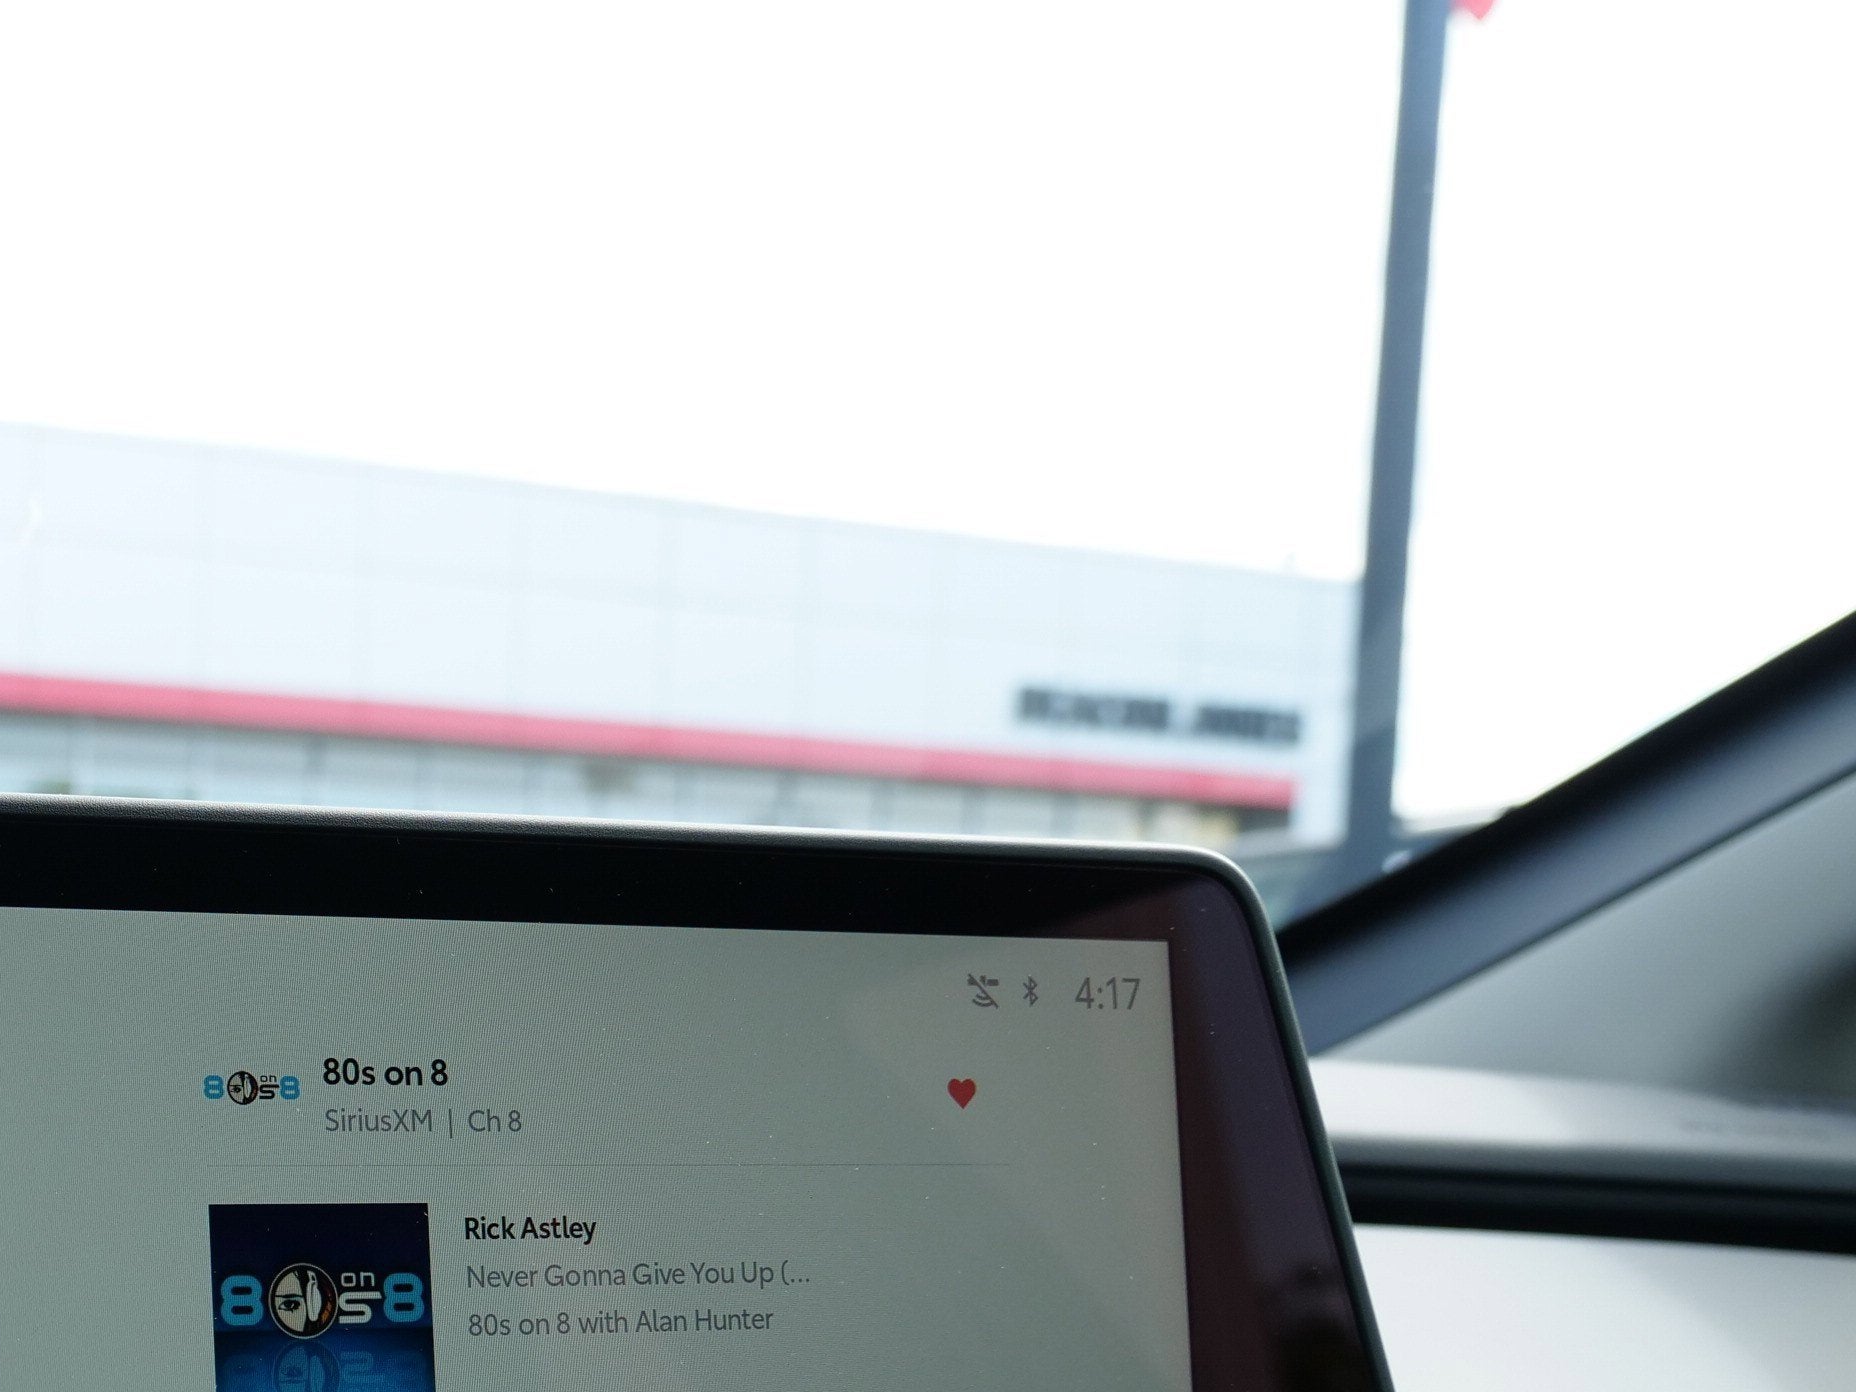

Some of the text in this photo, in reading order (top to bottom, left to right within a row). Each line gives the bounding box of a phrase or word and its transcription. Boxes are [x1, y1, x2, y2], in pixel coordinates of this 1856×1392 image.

[1075, 976, 1141, 1010] 4:17
[323, 1057, 449, 1086] 80s on 8
[324, 1108, 522, 1132] SiriusXM Ch 8
[464, 1215, 597, 1246] Rick Astley
[466, 1264, 538, 1288] Never
[544, 1264, 626, 1287] Gonna
[632, 1262, 686, 1286] Give
[690, 1261, 735, 1285] You
[741, 1261, 774, 1290] Up
[383, 1272, 425, 1323] 8
[468, 1308, 774, 1336] 80s on 8 with Alan Hunter
